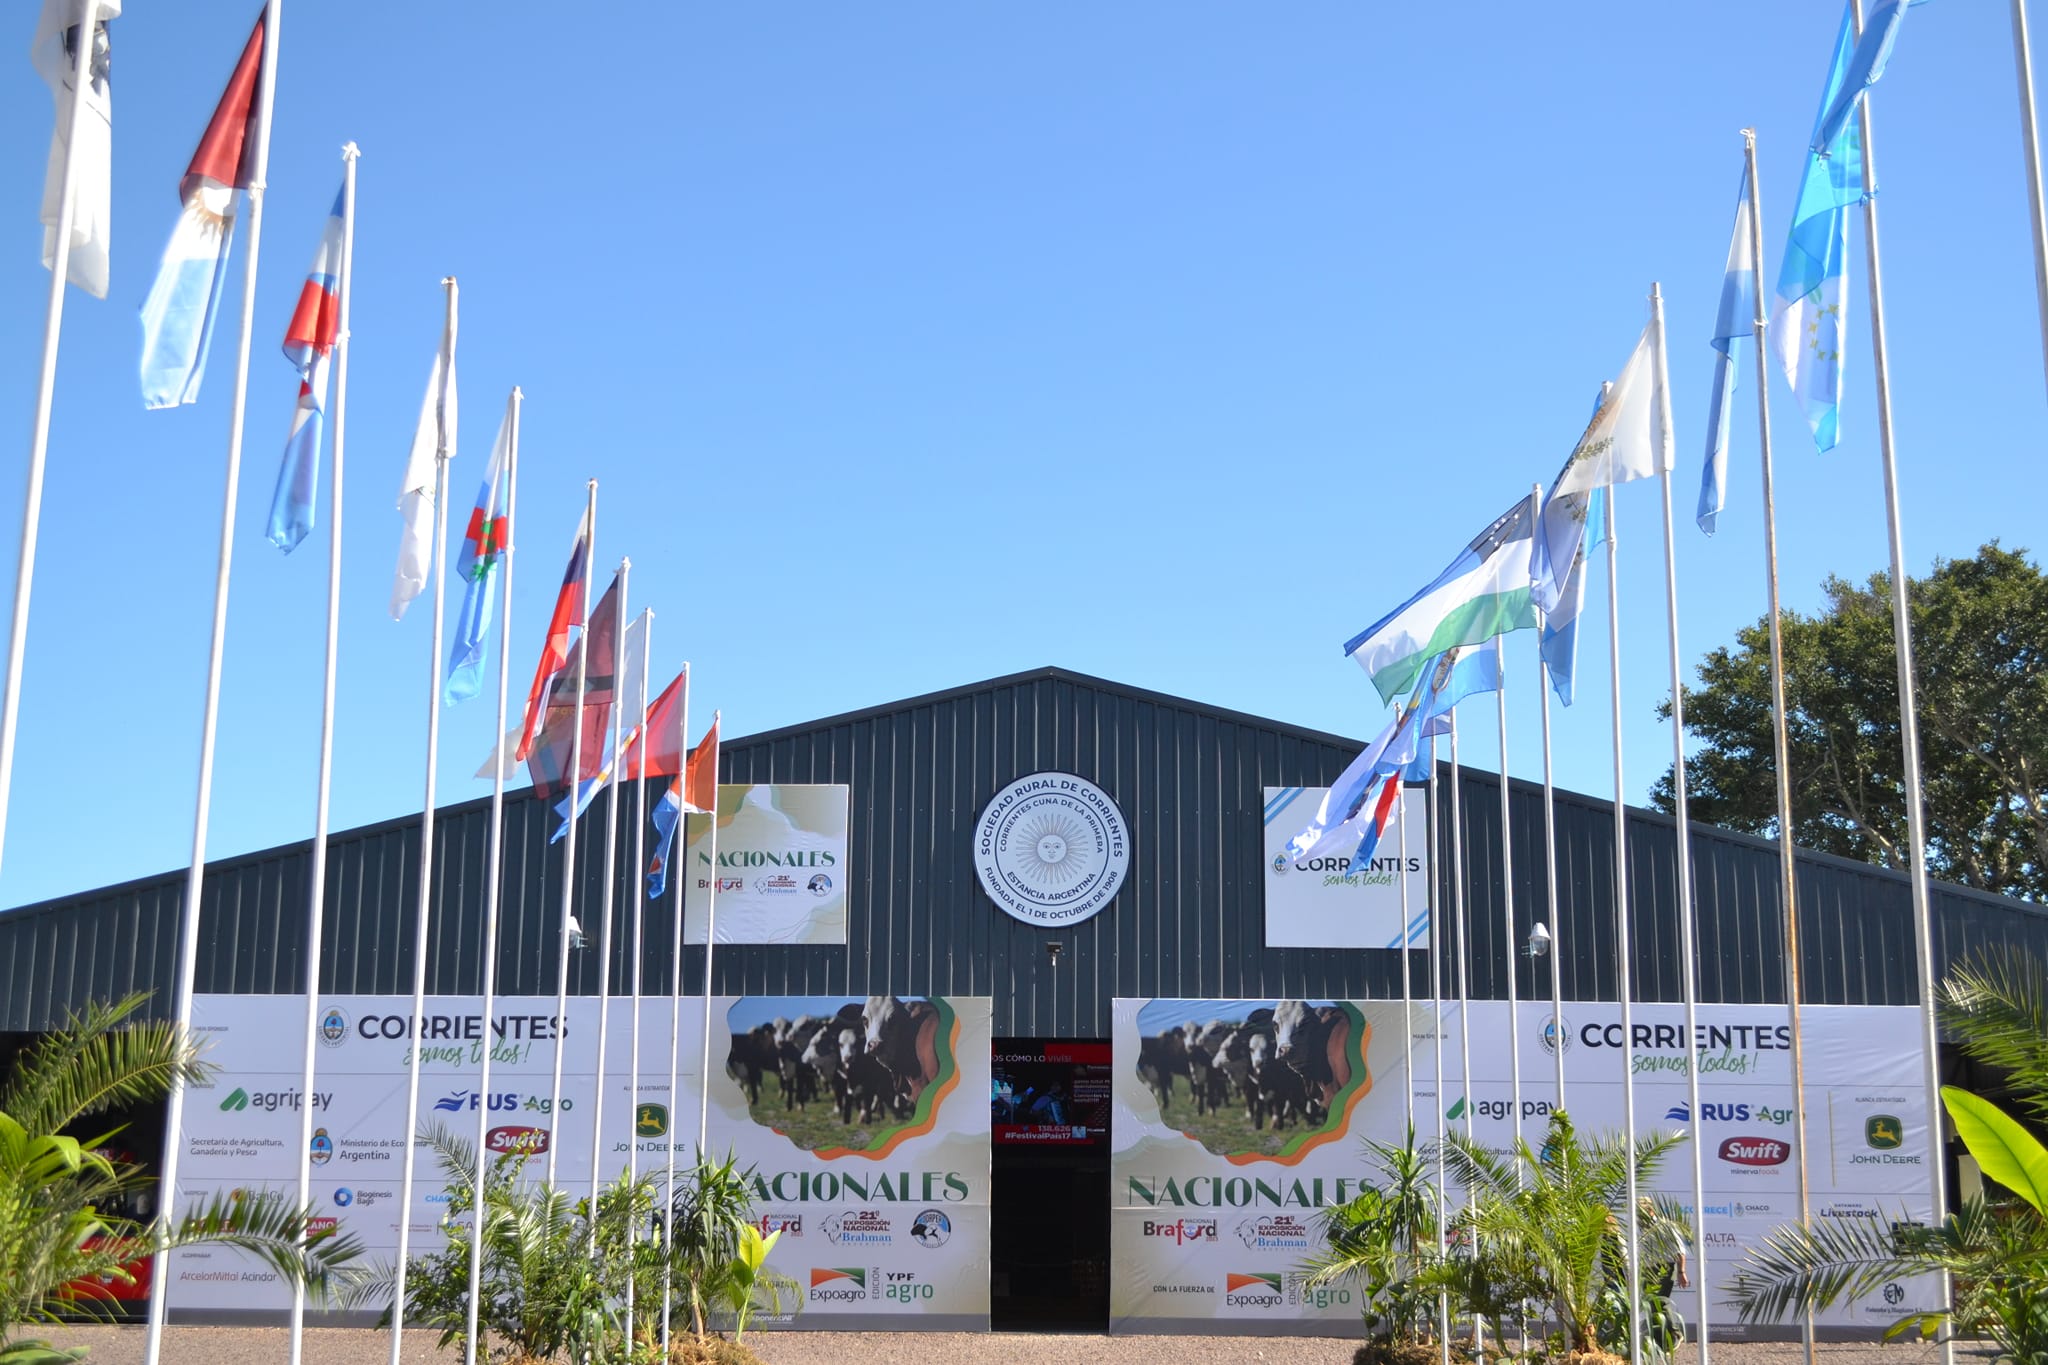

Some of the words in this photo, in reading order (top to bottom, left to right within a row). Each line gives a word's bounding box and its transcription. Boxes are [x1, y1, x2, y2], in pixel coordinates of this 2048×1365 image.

[982, 795, 1013, 855] SOCIEDAD
[1015, 780, 1057, 797] RURAL
[1061, 781, 1078, 792] DE
[1081, 789, 1123, 858] CORRIENTES
[1000, 804, 1031, 852] CORRIENTES
[1033, 798, 1058, 807] CUNA
[1061, 800, 1073, 809] DE
[1074, 805, 1085, 816] LA
[1085, 814, 1103, 854] PRIMERA
[698, 851, 835, 867] NACIONALES
[698, 877, 743, 894] Brford
[1007, 871, 1045, 900] ESTANCIA
[1048, 873, 1096, 901] ARGENTINA
[985, 867, 1014, 907] FUNDADA
[1016, 903, 1026, 914] EL
[1034, 910, 1047, 919] DE
[1050, 900, 1094, 919] OCTUBRE
[1093, 891, 1106, 903] DE
[1102, 871, 1118, 893] 1908
[358, 1014, 568, 1039] CORRIENTES
[1580, 1023, 1790, 1050] CORRIENTES
[1631, 1052, 1688, 1077] somos
[523, 1095, 573, 1114] Ago
[1479, 1101, 1553, 1120] agrpa
[1701, 1103, 1750, 1121] RUS
[1756, 1106, 1805, 1125] Agr
[229, 1138, 239, 1146] de
[380, 1139, 389, 1147] de
[613, 1142, 645, 1152] JON
[236, 1148, 258, 1156] Pesca
[340, 1150, 390, 1162] Argentina
[1727, 1142, 1781, 1159] Swift
[1849, 1153, 1880, 1164] JOHN
[1883, 1153, 1921, 1164] DEERE
[1820, 1208, 1879, 1218] Livestock
[842, 1232, 891, 1242] Brahman
[1258, 1237, 1308, 1247] Brahman
[1705, 1233, 1736, 1243] ALTA
[180, 1271, 239, 1281] ArcelorMittal
[241, 1271, 278, 1282] Acindar
[886, 1272, 916, 1281] YPF
[810, 1289, 866, 1303] Expoagro
[886, 1283, 934, 1303] agro
[1153, 1285, 1167, 1293] CON
[1179, 1286, 1206, 1294] FUERZA
[1226, 1294, 1282, 1308] Expoagro
